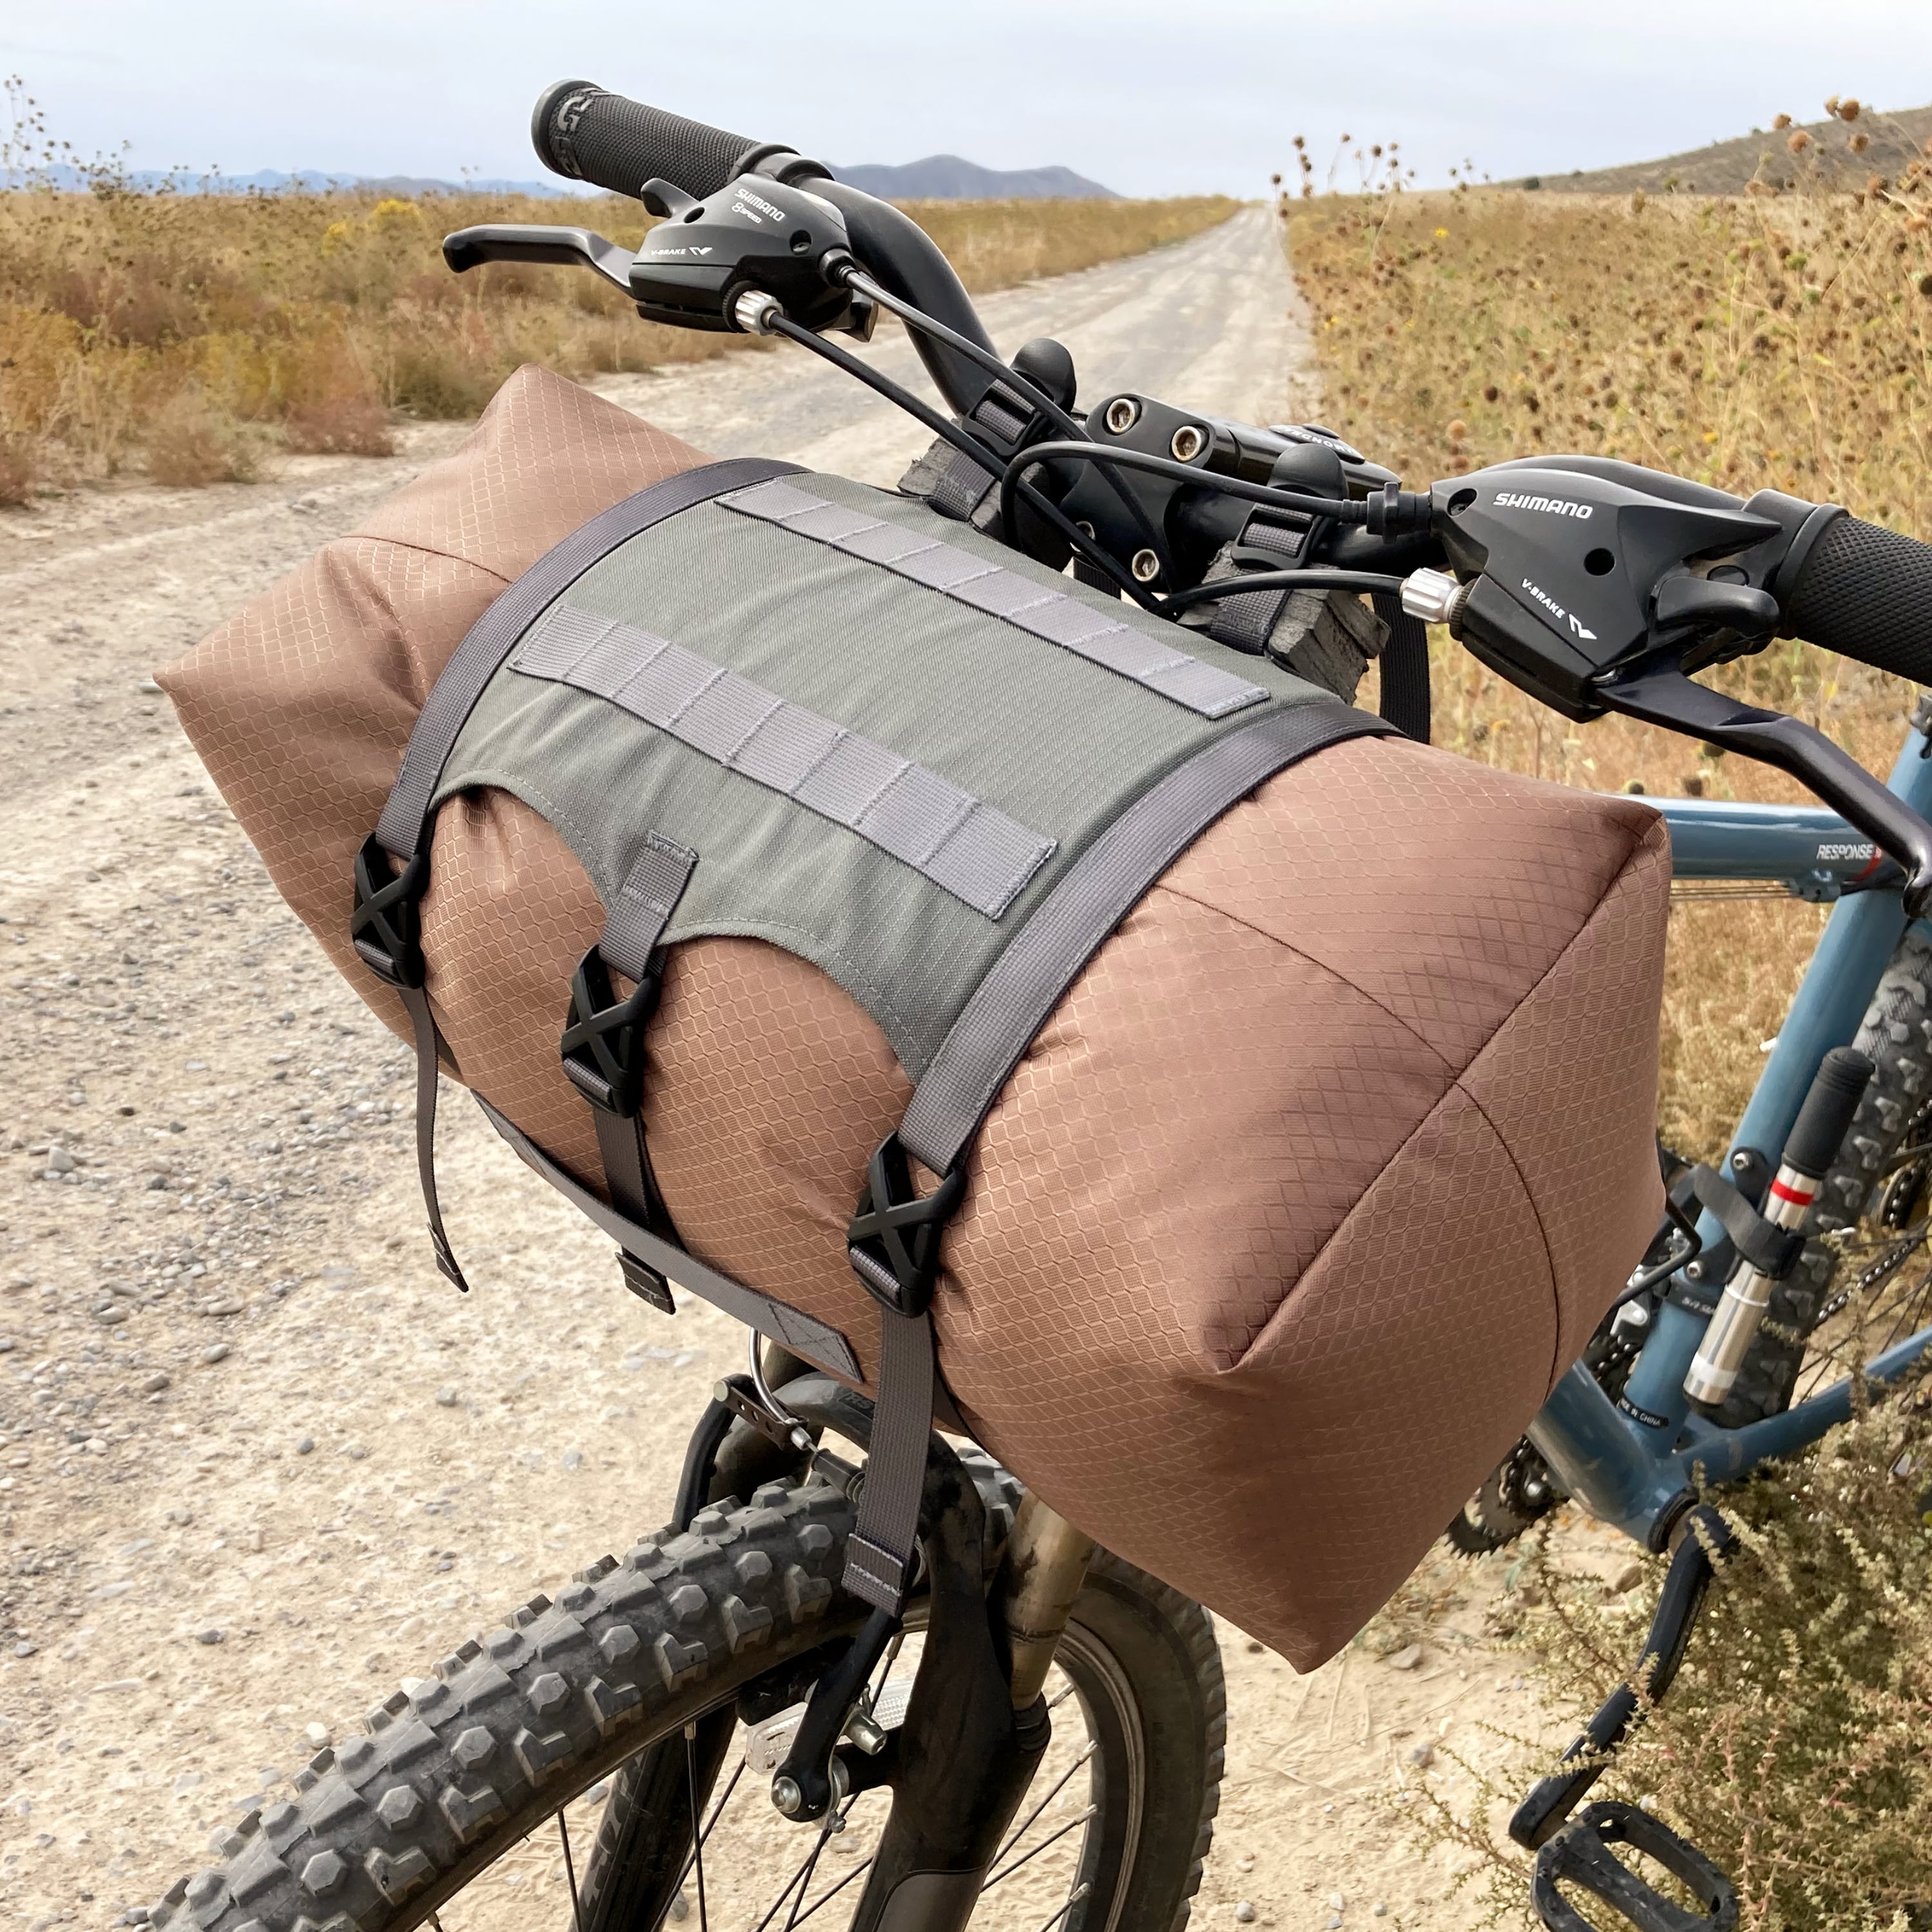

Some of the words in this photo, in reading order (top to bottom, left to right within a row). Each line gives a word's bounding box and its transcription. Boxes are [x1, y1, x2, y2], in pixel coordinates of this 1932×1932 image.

[734, 188, 786, 222] SHIMANO
[1493, 493, 1593, 519] SHIMANO
[1521, 578, 1566, 619] V-BRAKE
[1816, 844, 1873, 860] RESPONSE
[1639, 1412, 1662, 1426] CHINA
